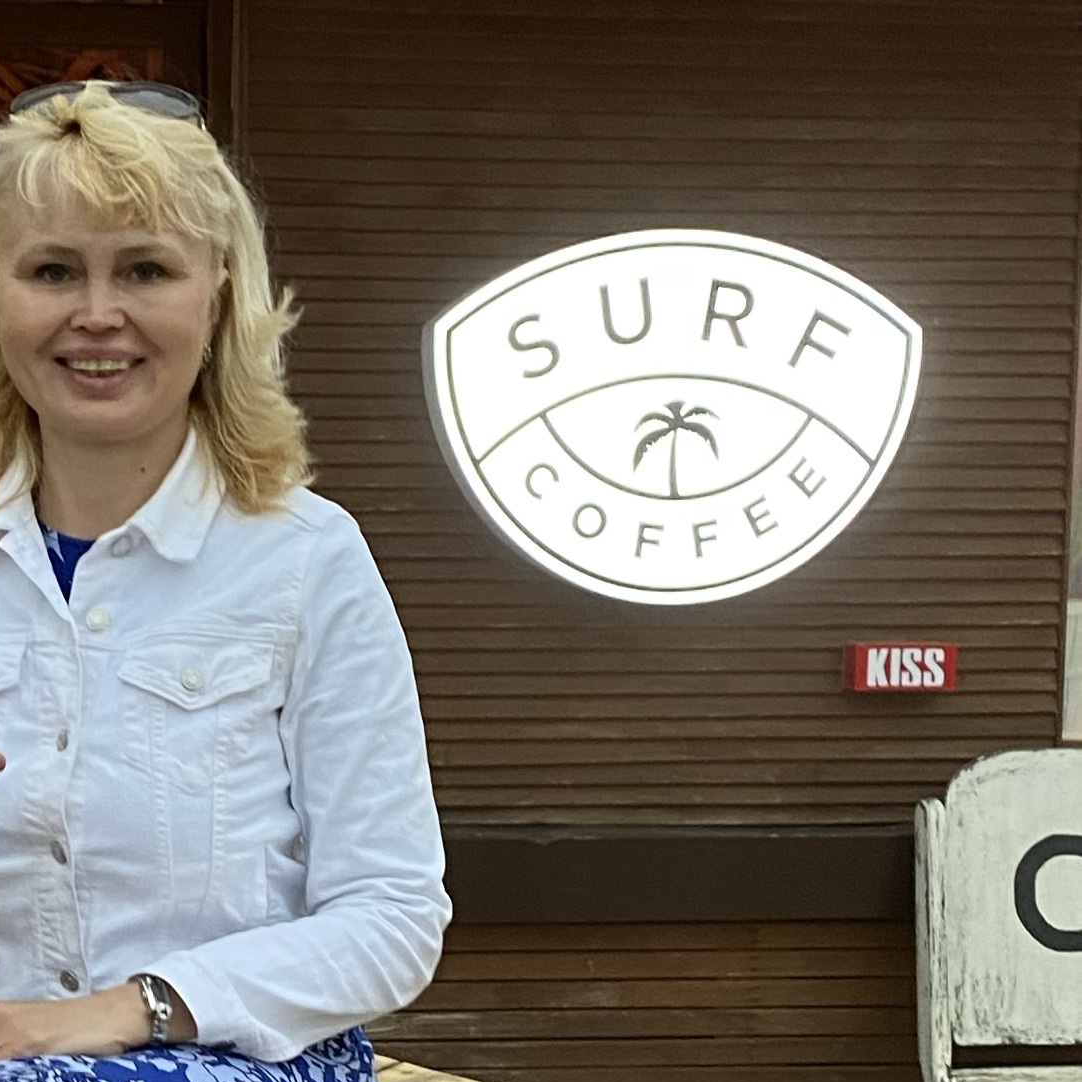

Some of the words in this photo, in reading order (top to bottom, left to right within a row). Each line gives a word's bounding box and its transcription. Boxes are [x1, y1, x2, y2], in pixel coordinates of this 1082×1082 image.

[507, 277, 852, 379] SURF
[525, 457, 827, 559] COFFEE
[866, 647, 945, 688] KISS
